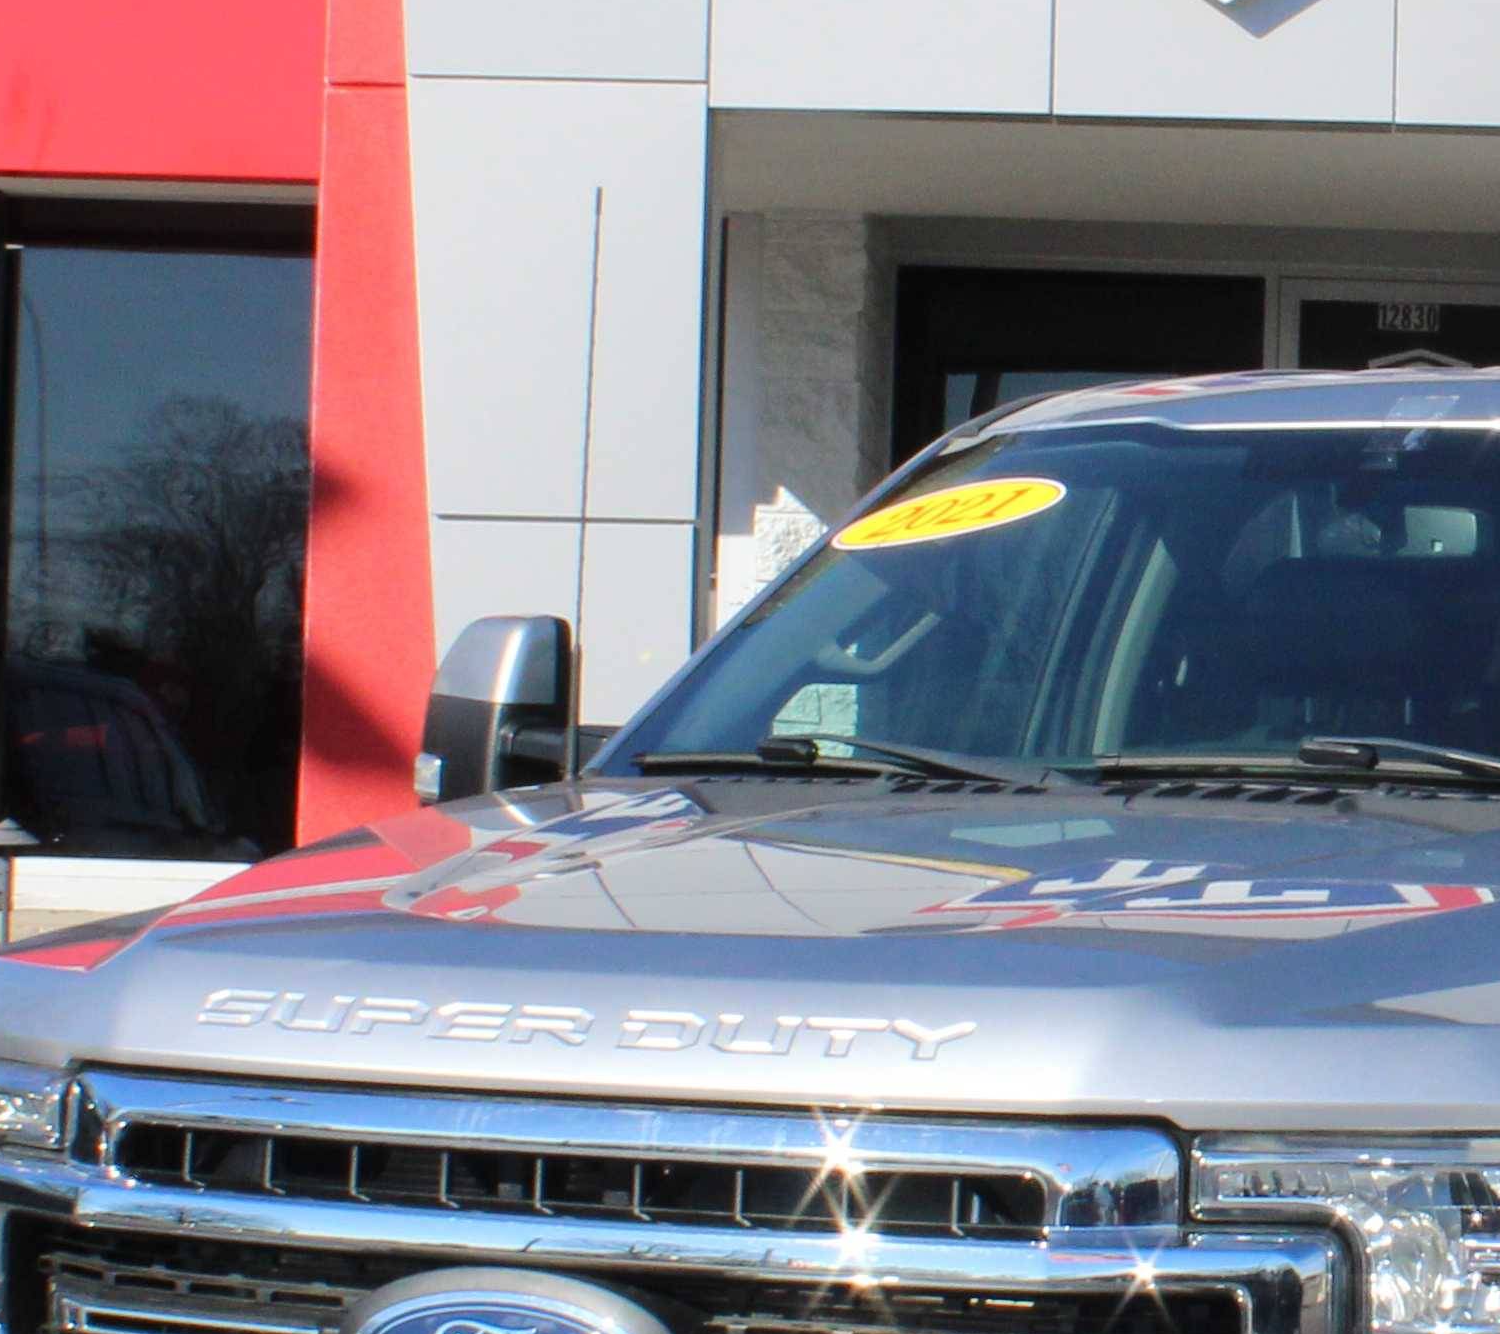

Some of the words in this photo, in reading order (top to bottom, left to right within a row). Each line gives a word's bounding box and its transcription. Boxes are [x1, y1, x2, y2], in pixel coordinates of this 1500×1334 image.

[1378, 303, 1440, 331] 12830
[860, 486, 1032, 541] 2021
[197, 987, 596, 1046] SUPER
[616, 1009, 979, 1061] DUTY
